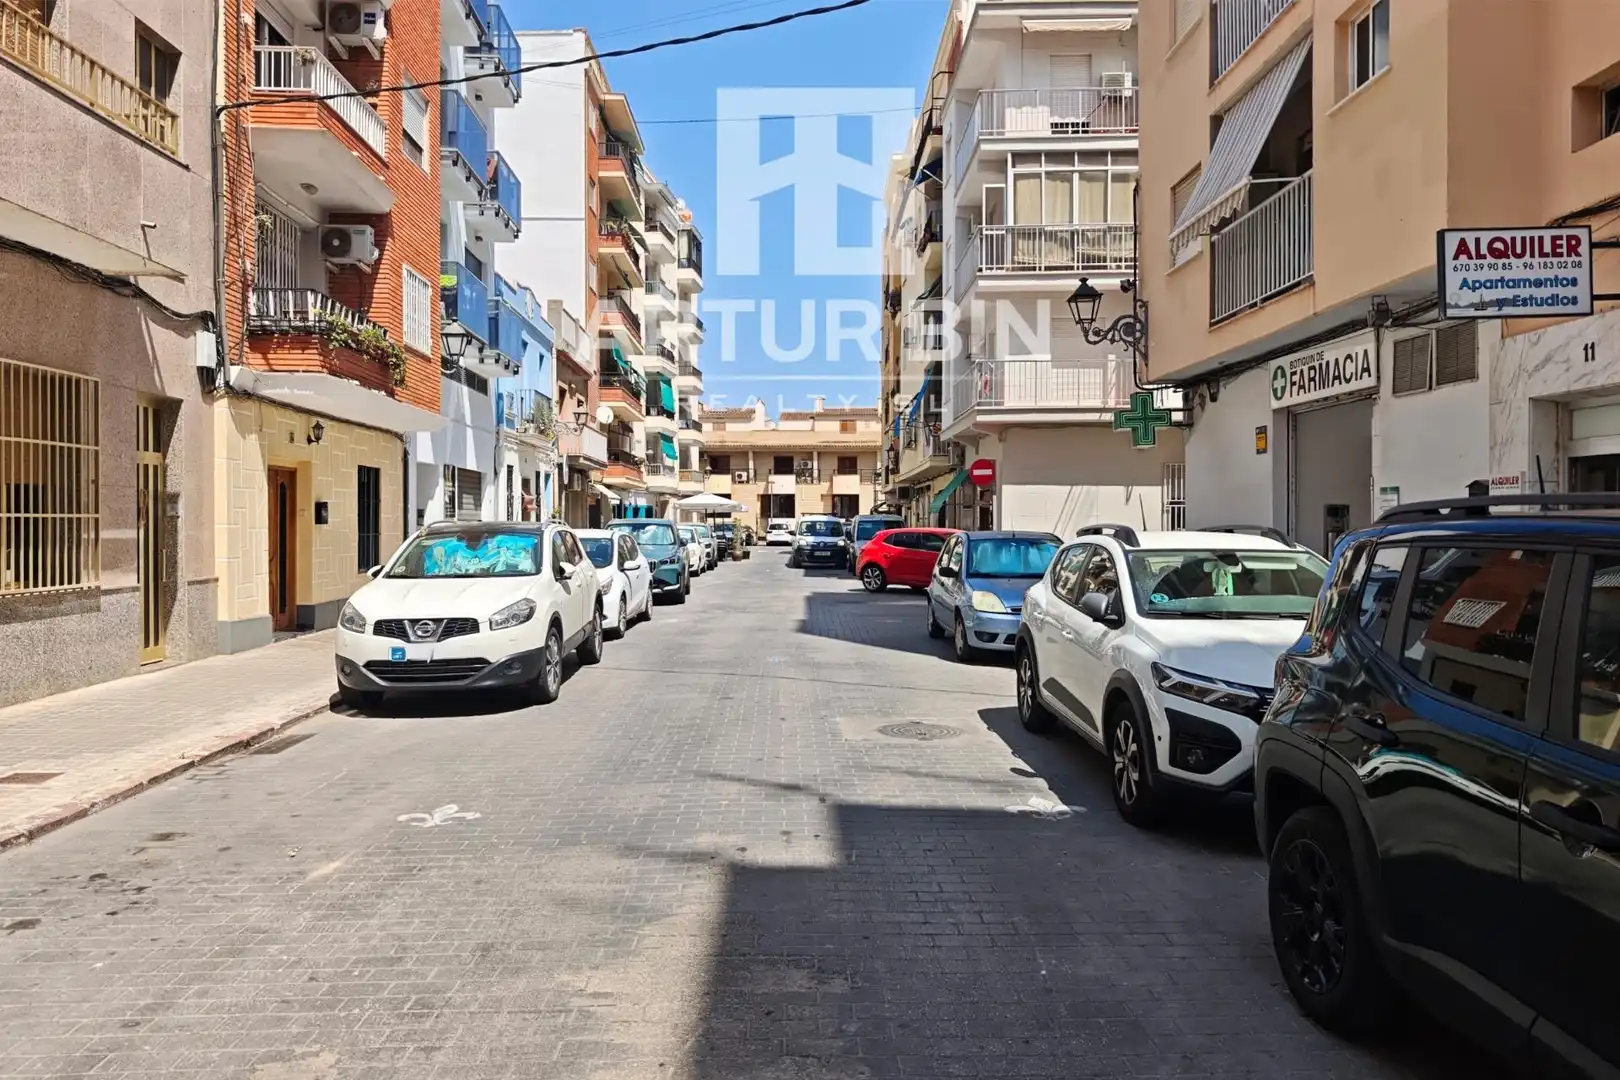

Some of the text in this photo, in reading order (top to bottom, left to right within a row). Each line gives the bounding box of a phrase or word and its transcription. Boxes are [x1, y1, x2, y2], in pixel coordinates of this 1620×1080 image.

[1452, 235, 1582, 261] ALQUILER
[1453, 263, 1470, 272] 670
[1473, 263, 1484, 272] 39
[1487, 262, 1499, 272] 90
[1501, 262, 1513, 271] 85
[1522, 261, 1534, 270] 96
[1537, 261, 1554, 270] 183
[1557, 261, 1568, 269] 02
[1571, 260, 1583, 269] 08
[1458, 275, 1578, 292] Apartamentos
[1496, 293, 1578, 311] y Estudios
[1316, 350, 1325, 362] DE
[1582, 341, 1596, 363] 11
[1289, 348, 1372, 398] FARMACIA
